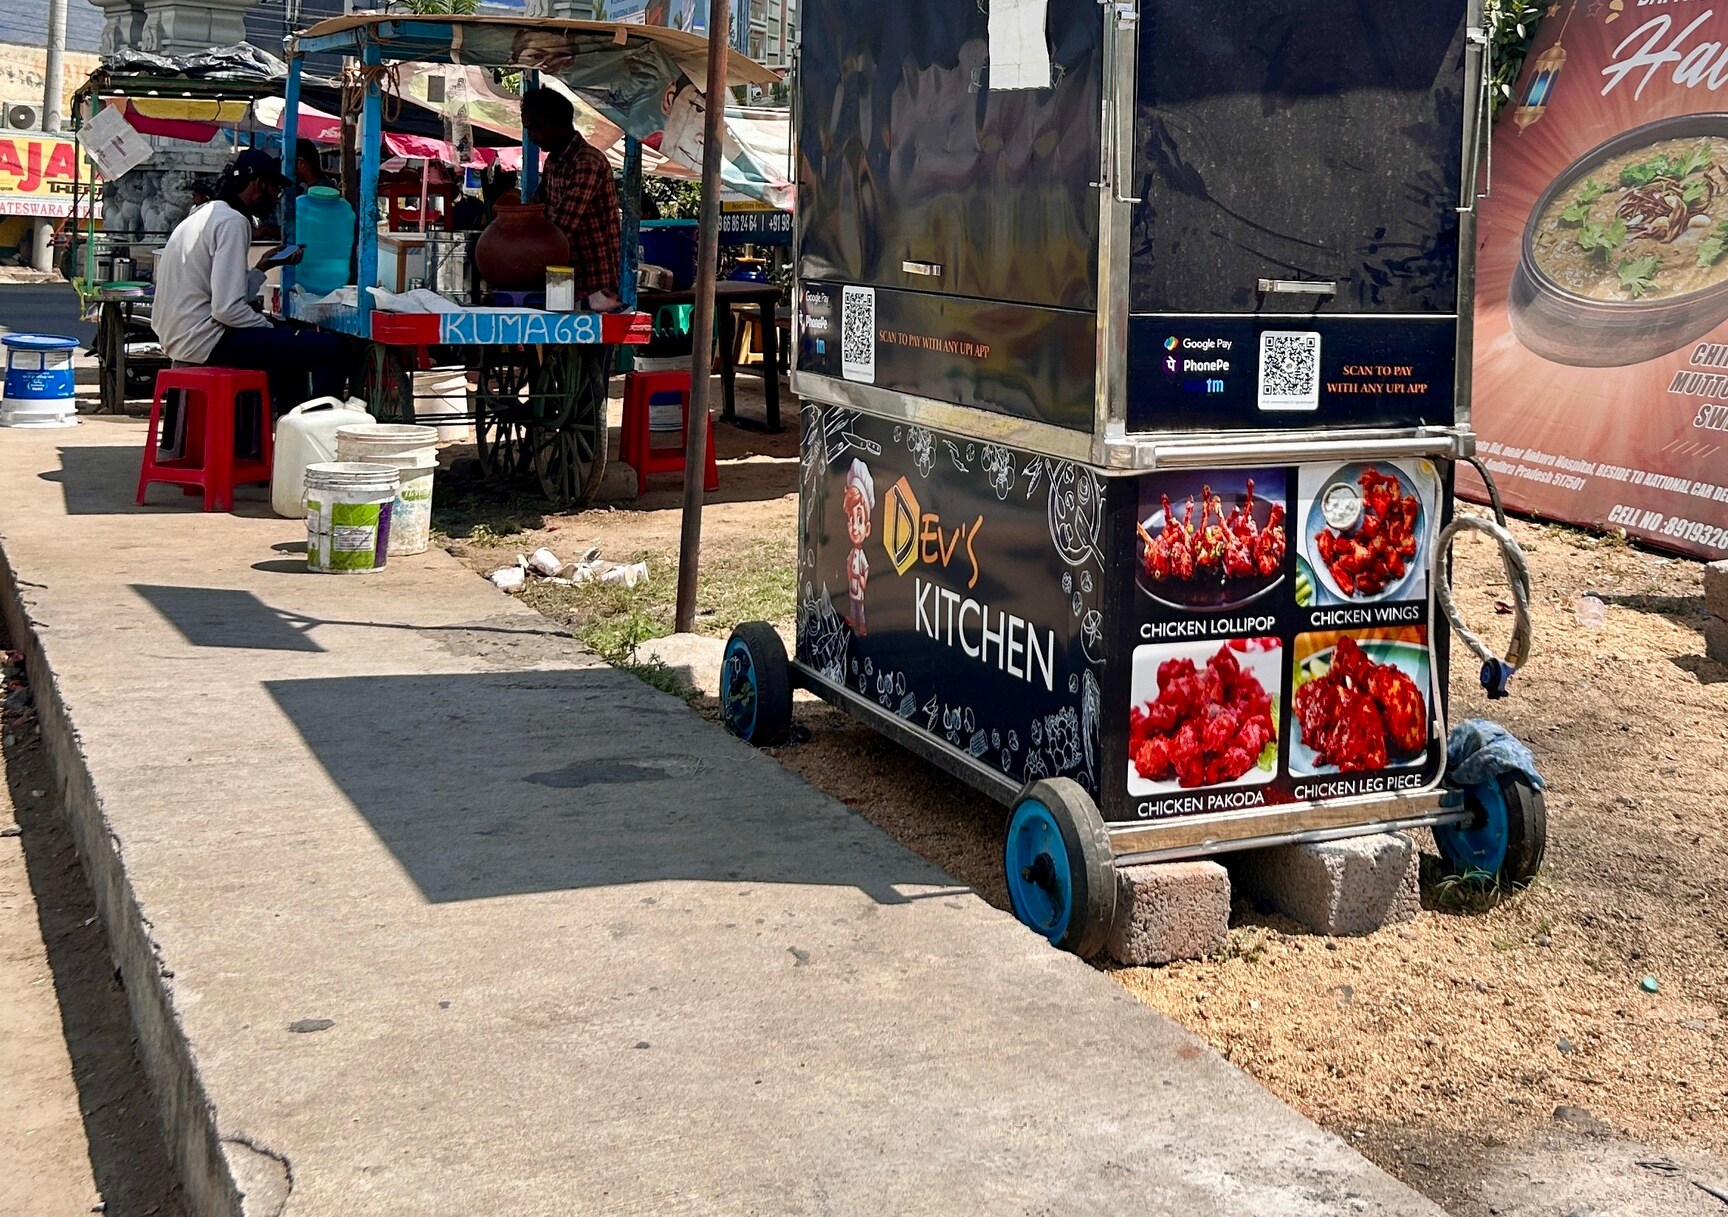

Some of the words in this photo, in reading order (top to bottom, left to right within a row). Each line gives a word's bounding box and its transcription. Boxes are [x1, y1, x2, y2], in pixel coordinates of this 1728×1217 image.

[878, 329, 897, 344] SCAN
[898, 332, 908, 345] TO
[909, 334, 921, 348] PAY
[922, 336, 942, 352] WITH
[943, 340, 960, 353] ANY
[960, 342, 973, 356] UPI
[974, 344, 990, 359] APP
[1182, 338, 1215, 351] Google
[1217, 338, 1232, 351] Pay
[1183, 358, 1230, 372] PhonePe
[1342, 365, 1373, 376] SCAN
[1375, 366, 1392, 376] TO
[1393, 366, 1414, 376] PAY
[1326, 383, 1359, 393] WITH
[1360, 383, 1384, 393] ANY
[1385, 383, 1405, 394] UPI
[1406, 383, 1428, 394] APP
[1501, 446, 1524, 459] near
[1595, 464, 1632, 482] BESIDE
[1629, 469, 1645, 484] TO
[1643, 472, 1692, 494] NATIONAL
[1690, 481, 1715, 499] CAR
[1514, 464, 1554, 484] Pradesh
[1608, 504, 1642, 527] CELL
[1638, 511, 1664, 531] NO
[884, 476, 984, 589] DEV'S
[1140, 620, 1206, 638] CHICKEN
[1210, 616, 1276, 634] LOLLIPOP
[1310, 609, 1371, 626] CHICKEN
[1374, 606, 1419, 623] WINGS
[915, 578, 1055, 692] KITCHEN
[1294, 781, 1355, 800] CHICKEN
[1359, 778, 1384, 794] LEG
[1387, 774, 1422, 791] PIECE
[1138, 798, 1203, 817] CHICKEN
[1207, 791, 1265, 810] PAKODA
